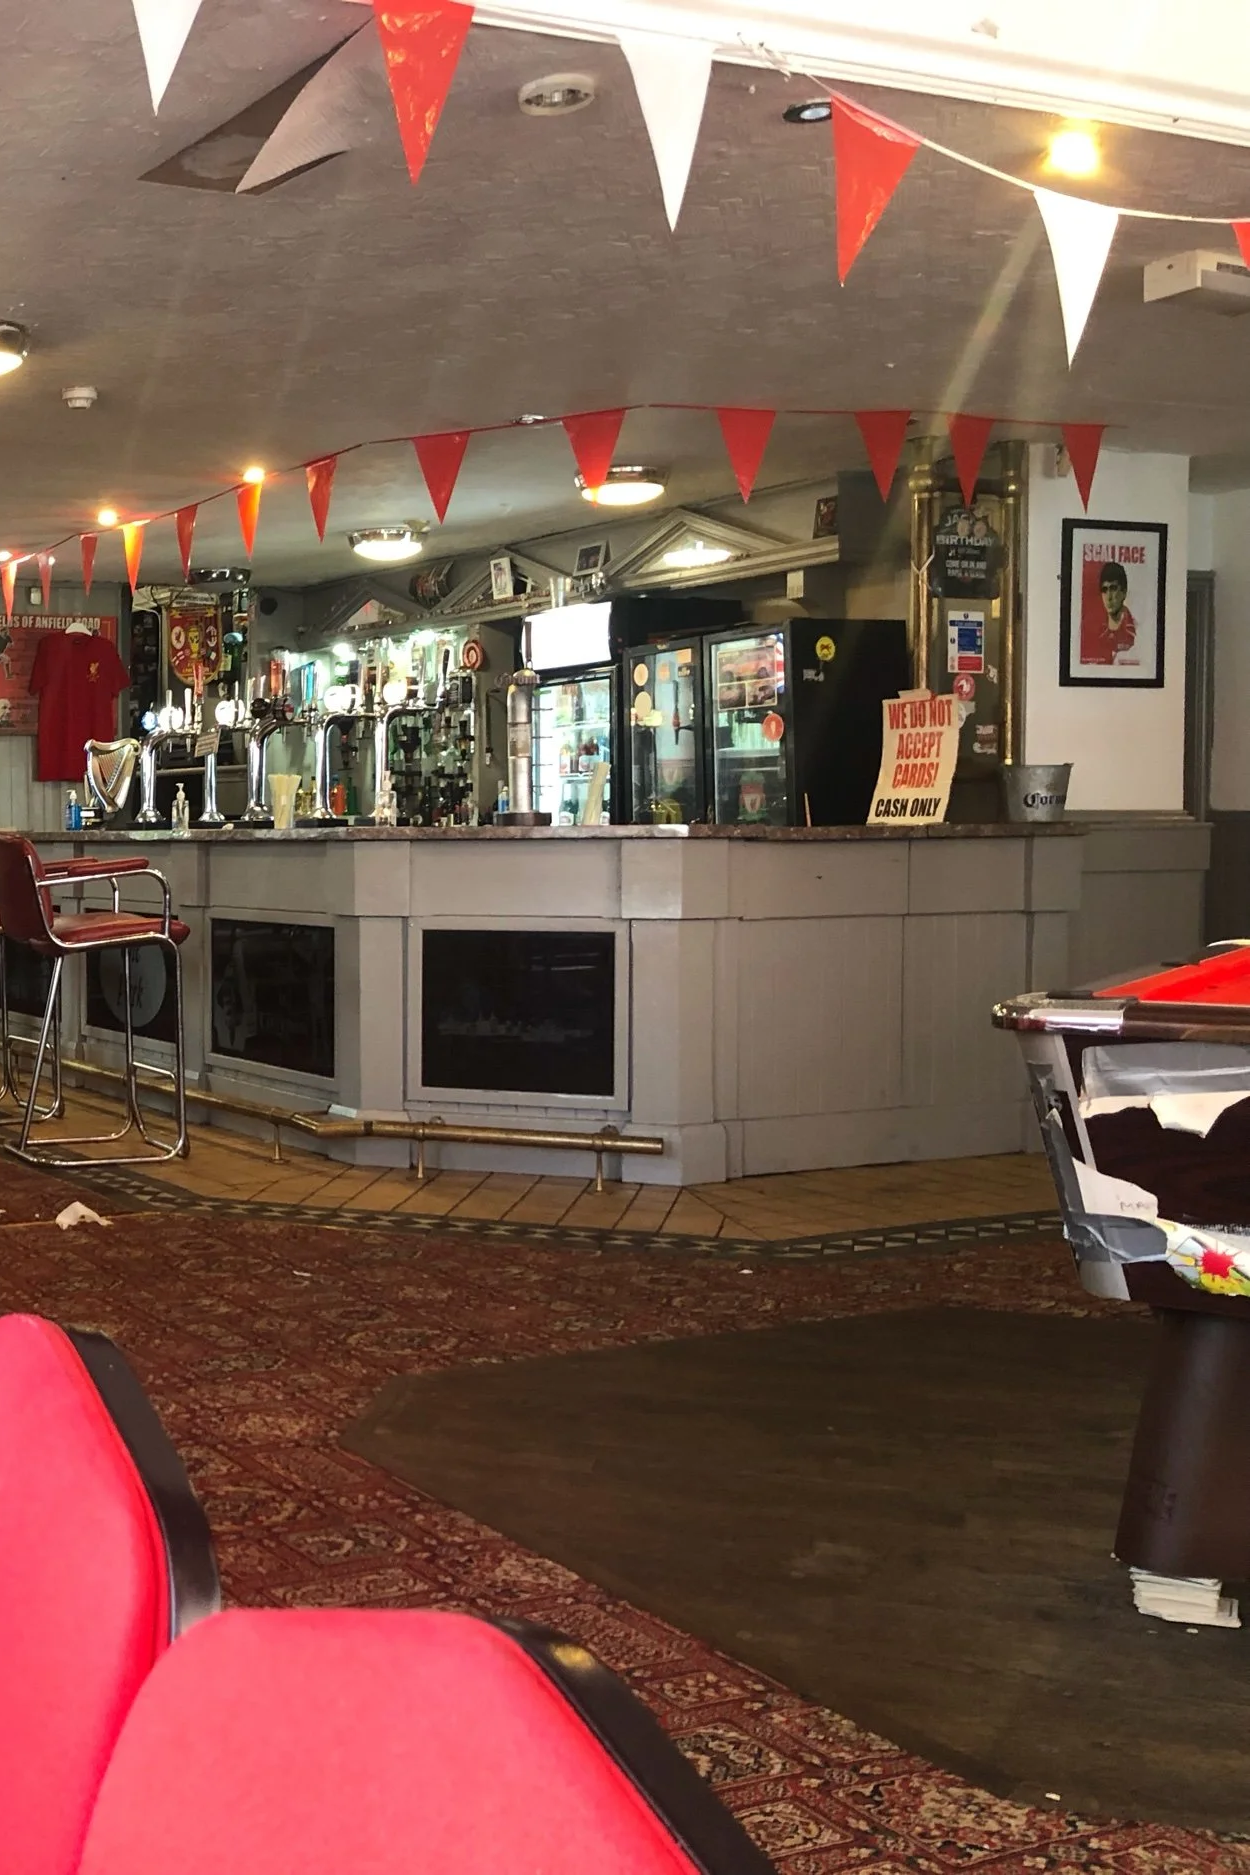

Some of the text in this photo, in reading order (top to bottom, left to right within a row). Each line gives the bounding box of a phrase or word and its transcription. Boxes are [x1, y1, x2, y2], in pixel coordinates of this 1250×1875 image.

[22, 616, 33, 628] OF
[888, 699, 952, 730] WE DO NOT
[896, 732, 944, 760] ACCEPT
[892, 762, 940, 789] CARDS!
[874, 797, 942, 818] CASH ONLY
